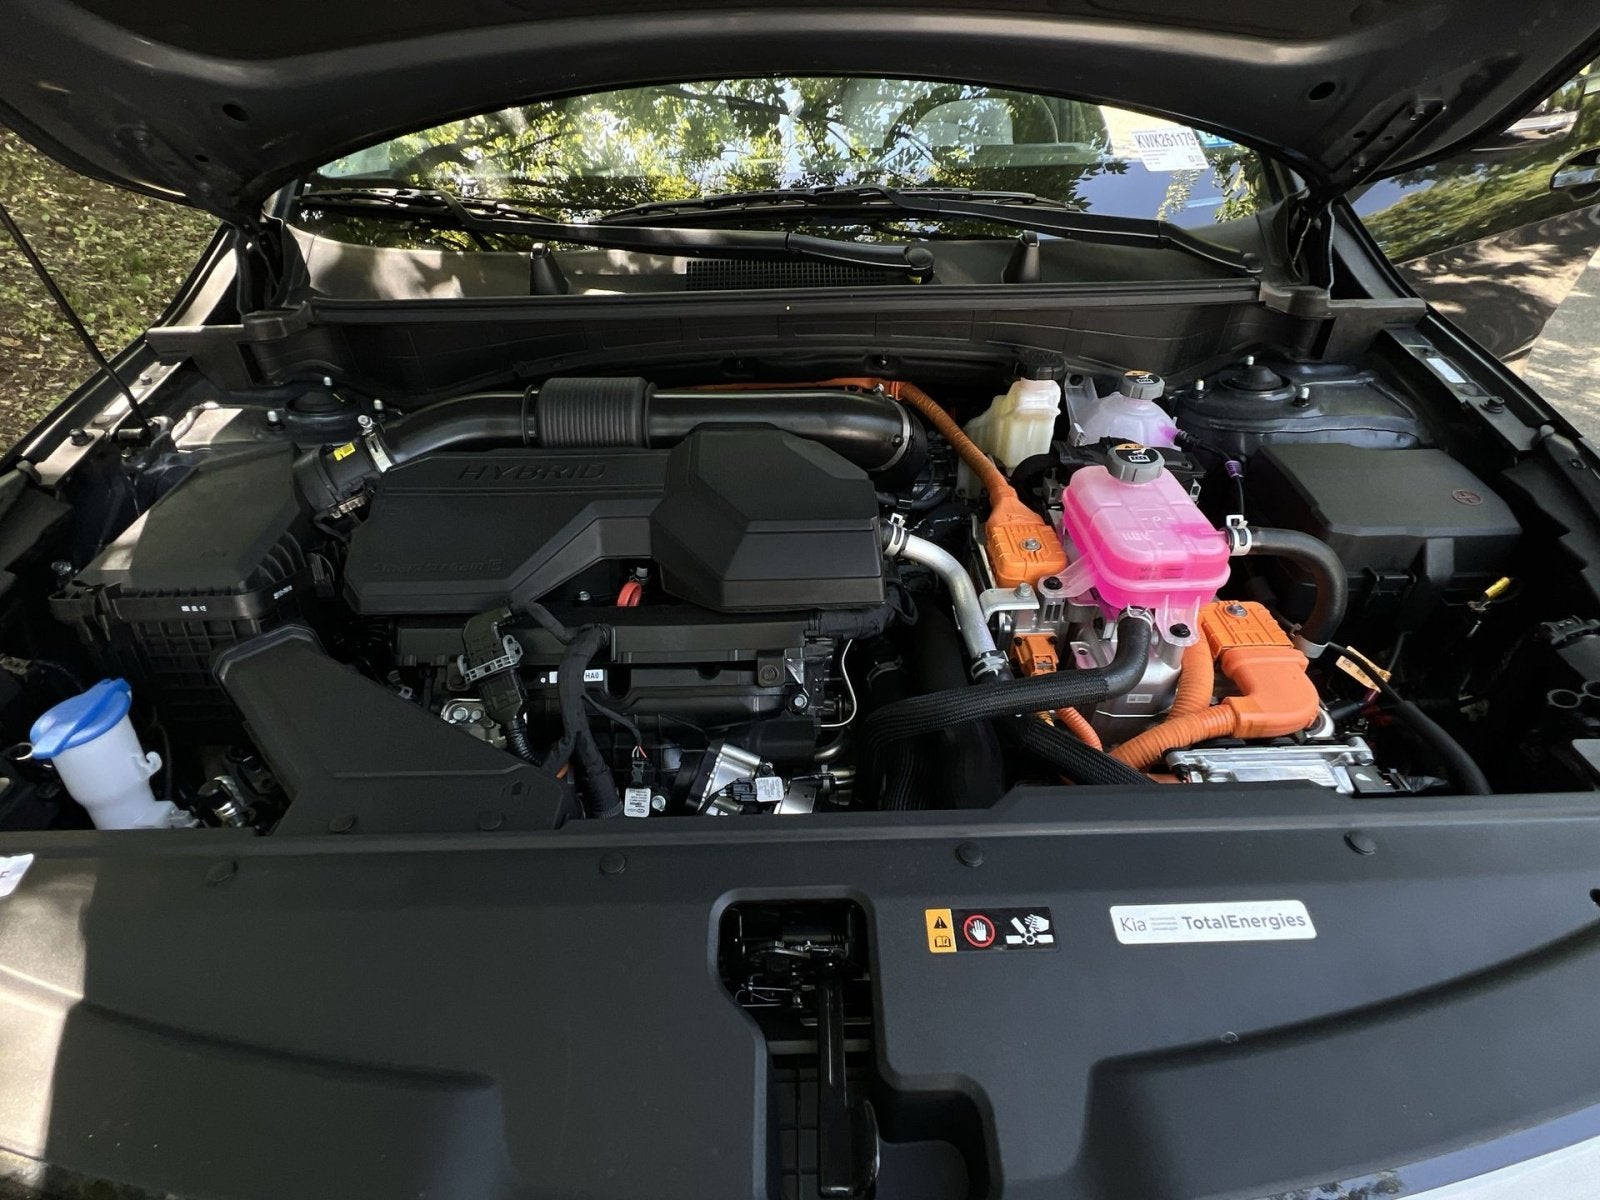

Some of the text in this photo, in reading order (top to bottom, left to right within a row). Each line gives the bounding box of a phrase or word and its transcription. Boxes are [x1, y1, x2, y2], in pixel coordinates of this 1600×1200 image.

[455, 463, 607, 481] HYBRID
[1119, 913, 1307, 932] Kia TotalEnergies
